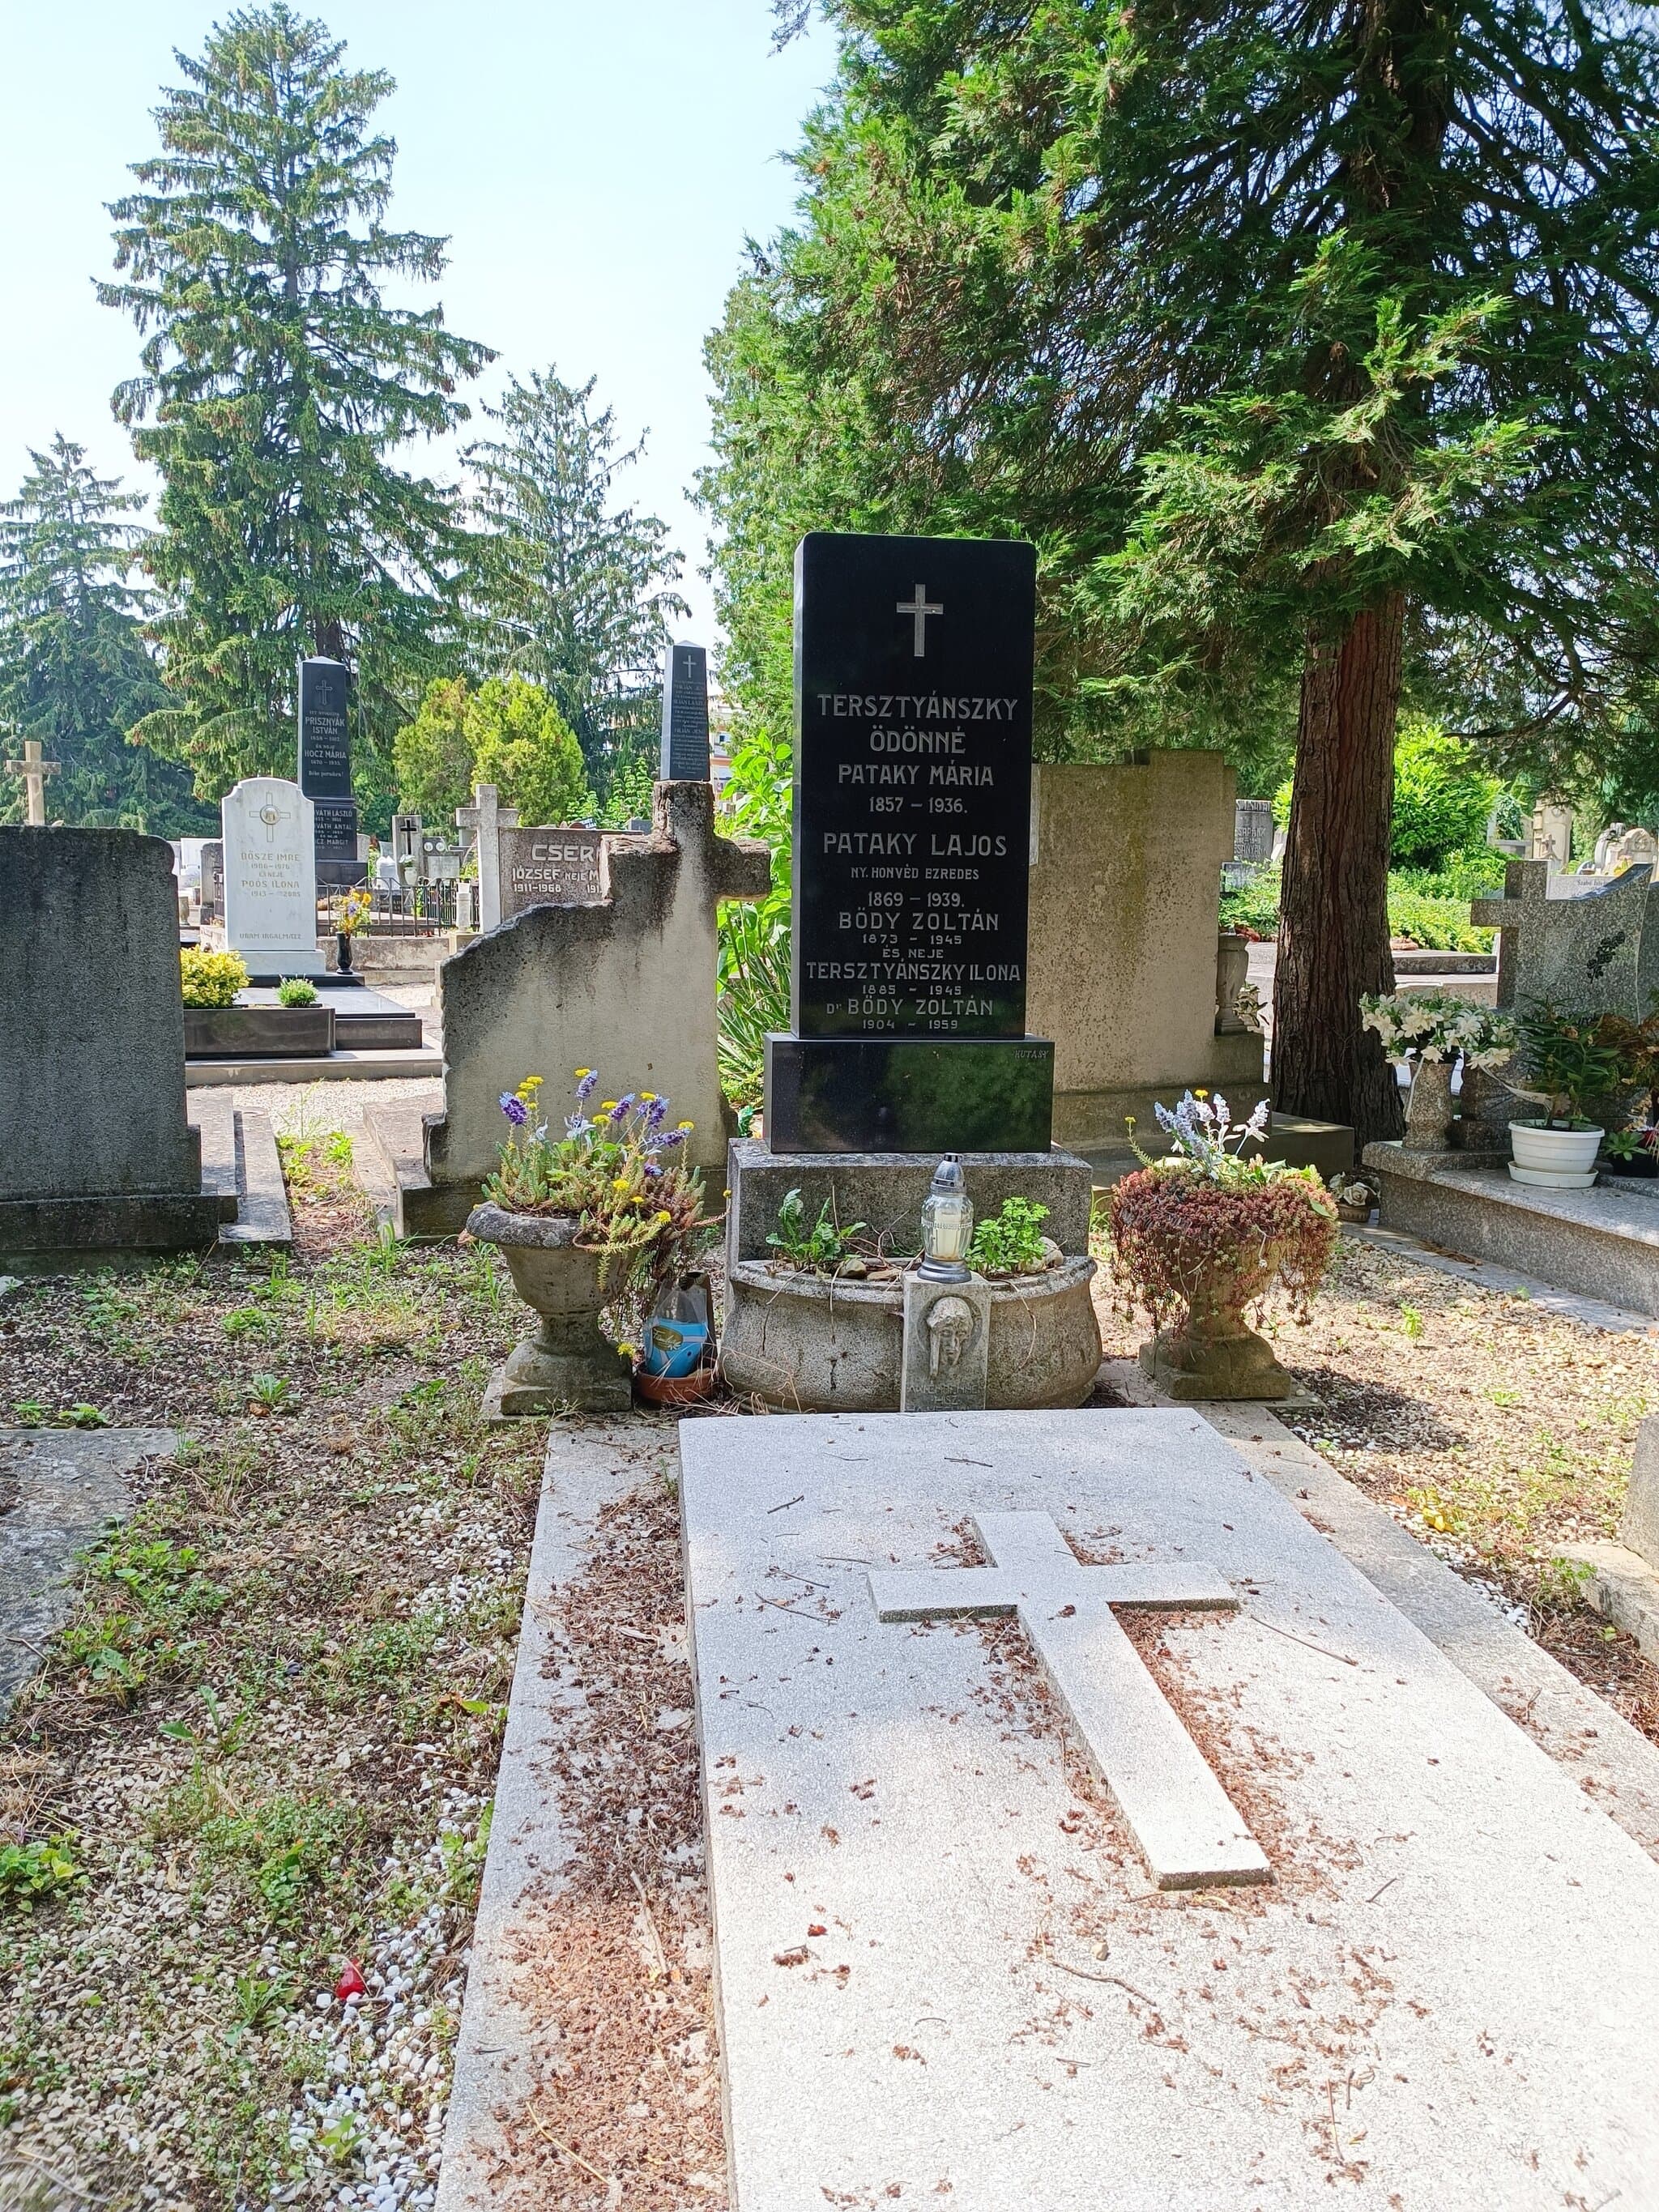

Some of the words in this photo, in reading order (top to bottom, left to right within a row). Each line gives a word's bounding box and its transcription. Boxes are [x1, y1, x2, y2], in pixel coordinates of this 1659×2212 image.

[817, 690, 1017, 720] TERSZTYÁNSZKY
[869, 724, 966, 753] ÖDÖNNÉ
[838, 764, 919, 784] PATAKY
[929, 760, 995, 786] MÁRIA
[869, 797, 903, 812] 1857
[928, 797, 968, 813] 1936.
[531, 844, 595, 863] CSER
[824, 833, 917, 855] PATAKY
[932, 834, 1007, 856] LAJOS
[512, 864, 561, 882] JÓZSEF
[565, 872, 586, 881] NEJE
[589, 871, 599, 881] M
[851, 867, 868, 878] NY.
[871, 863, 919, 879] HONVÉD
[925, 867, 979, 880] EZREDES
[514, 884, 561, 893] 1911-1968
[586, 884, 602, 893] 191
[868, 892, 903, 906] 1869
[927, 893, 965, 907] 1939.
[912, 908, 999, 931] ZOLTÁN
[863, 934, 898, 944] 1873
[930, 935, 962, 944] 1945
[882, 944, 900, 957] ÉS
[908, 948, 944, 958] NEJE
[807, 957, 966, 980] TERSZTYÁNSZKY
[970, 964, 1021, 981] ILONA
[862, 985, 896, 995] 1885
[929, 986, 962, 995] 1945
[915, 995, 993, 1016] ZOLTÁN
[863, 1019, 895, 1029] 1904
[928, 1020, 958, 1029] 1959
